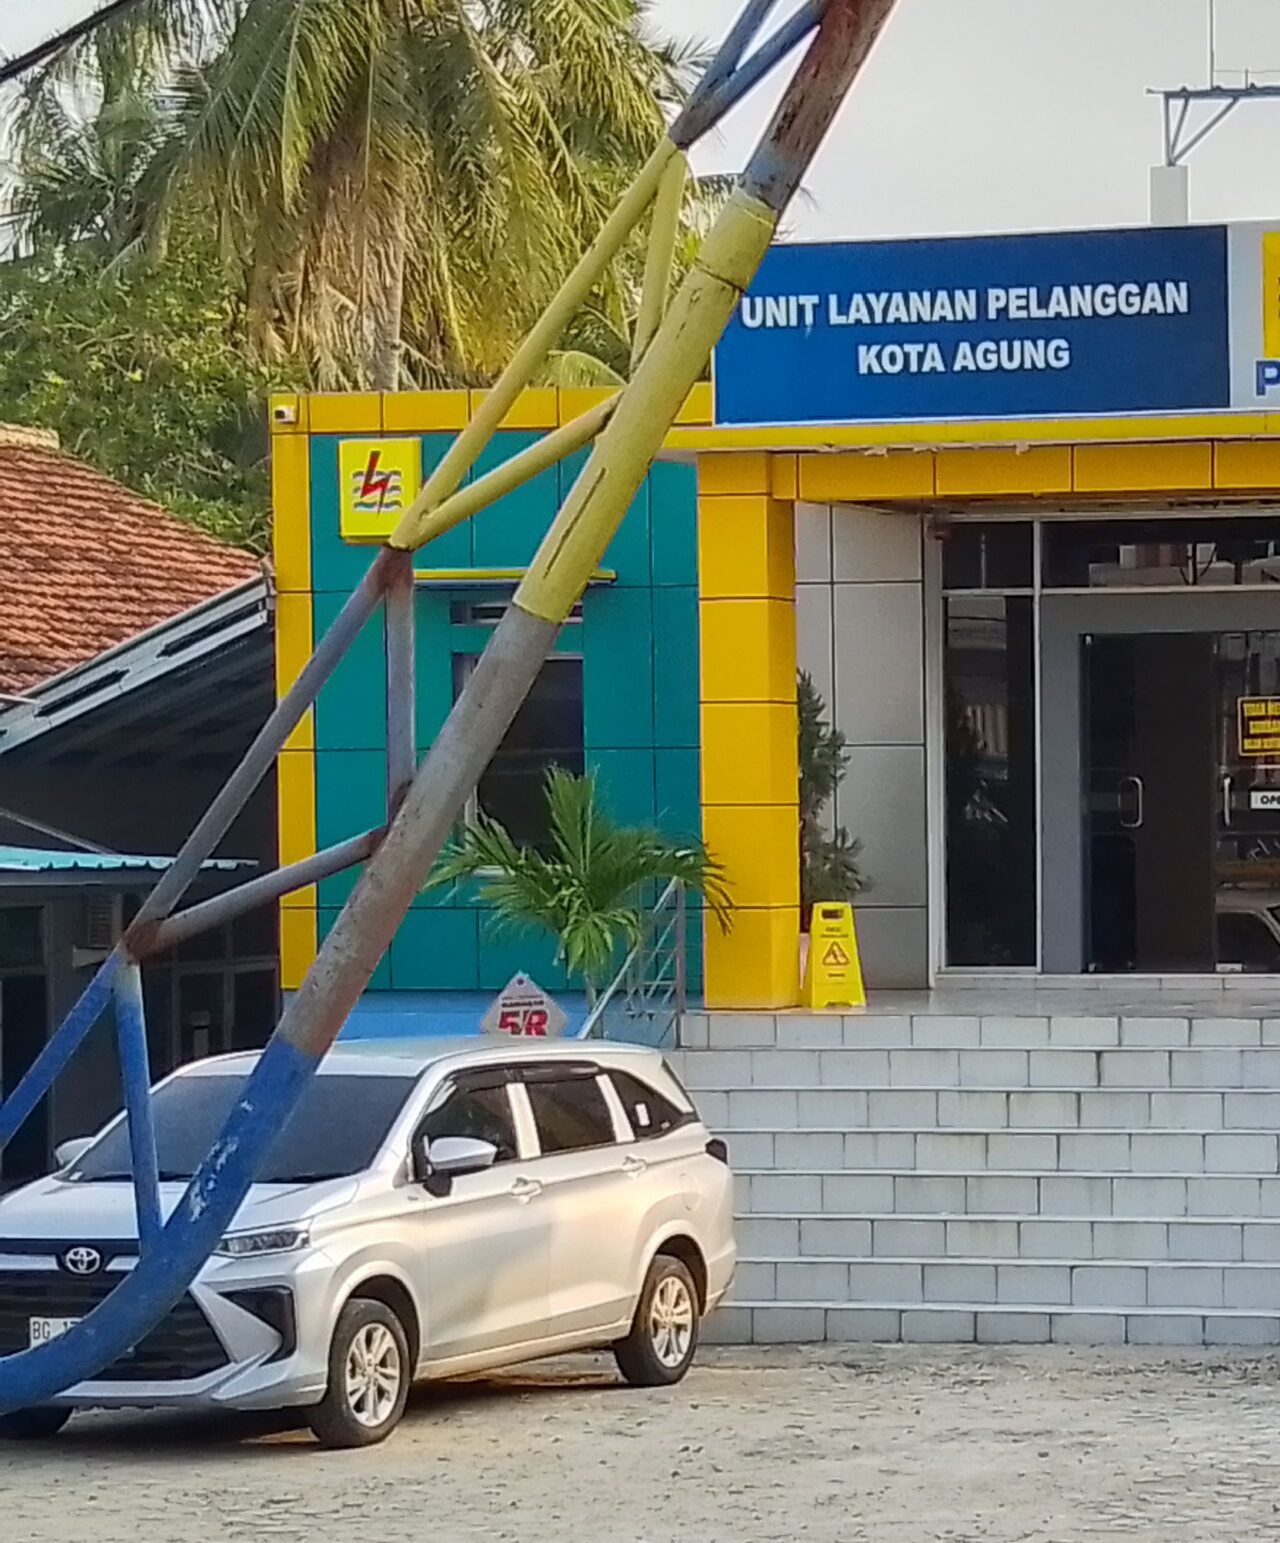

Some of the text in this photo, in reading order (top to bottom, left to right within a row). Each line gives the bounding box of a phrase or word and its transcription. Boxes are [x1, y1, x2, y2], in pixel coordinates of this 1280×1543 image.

[741, 281, 1189, 328] UNIT LAYANAN PELANGGAN
[857, 338, 1071, 375] KOTA AGUNG
[32, 1320, 51, 1340] BG
